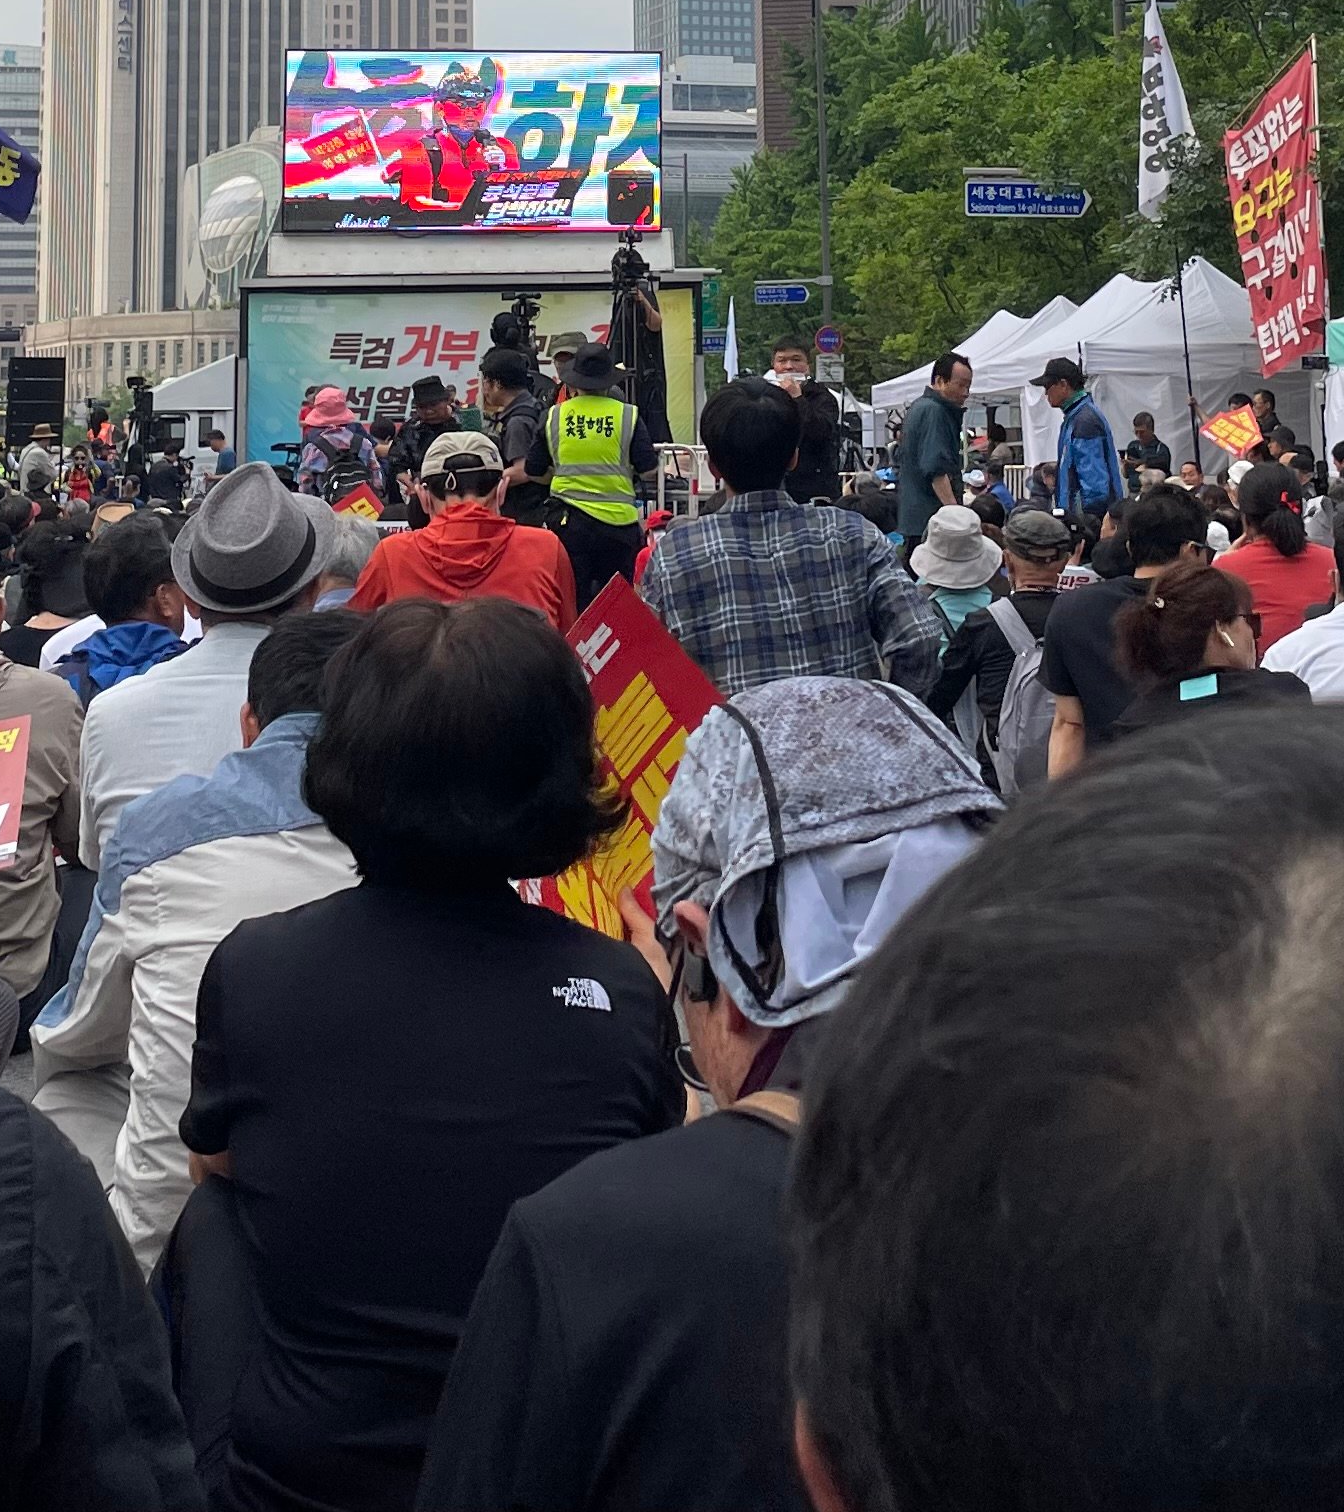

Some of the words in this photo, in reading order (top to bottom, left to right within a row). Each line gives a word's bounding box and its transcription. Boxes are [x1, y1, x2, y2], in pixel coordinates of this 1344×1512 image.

[1233, 167, 1296, 237] 요구는
[328, 332, 394, 370] 특검
[397, 324, 480, 371] 거부
[564, 408, 614, 441] 촛불행동
[552, 986, 593, 997] NORTH
[567, 977, 591, 989] THE
[564, 995, 594, 1008] FACE
